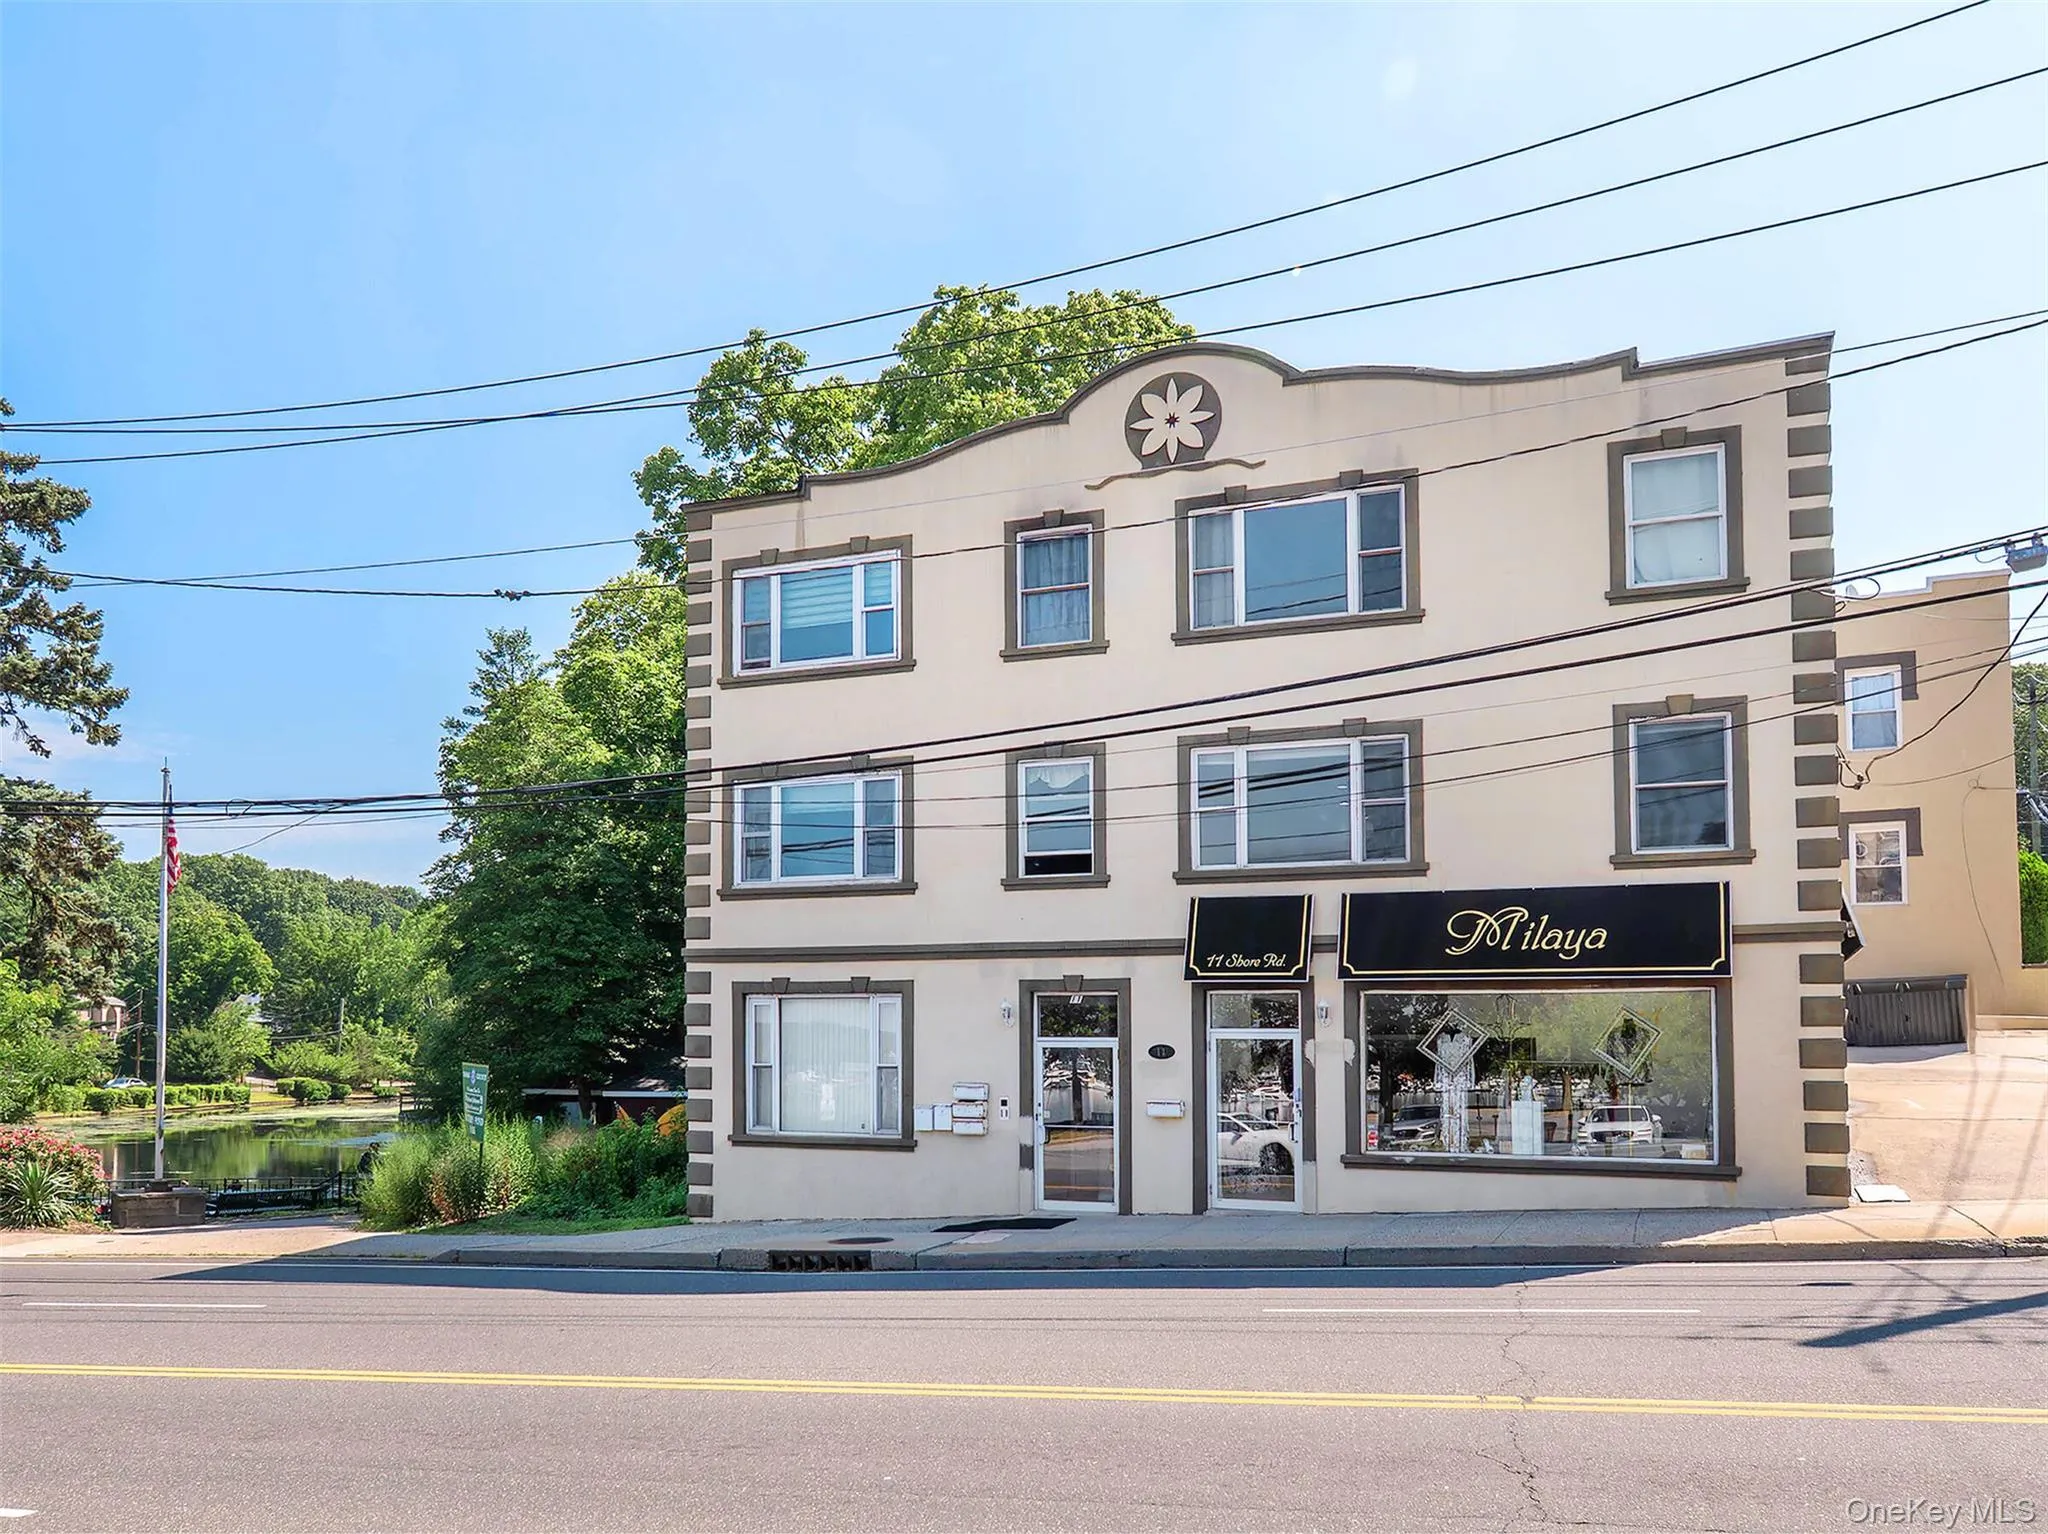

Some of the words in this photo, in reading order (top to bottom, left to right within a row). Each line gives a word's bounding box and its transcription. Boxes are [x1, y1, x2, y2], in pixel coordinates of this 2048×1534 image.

[1445, 906, 1607, 960] Milaya
[1207, 954, 1224, 967] 11
[1263, 953, 1286, 967] Rd.
